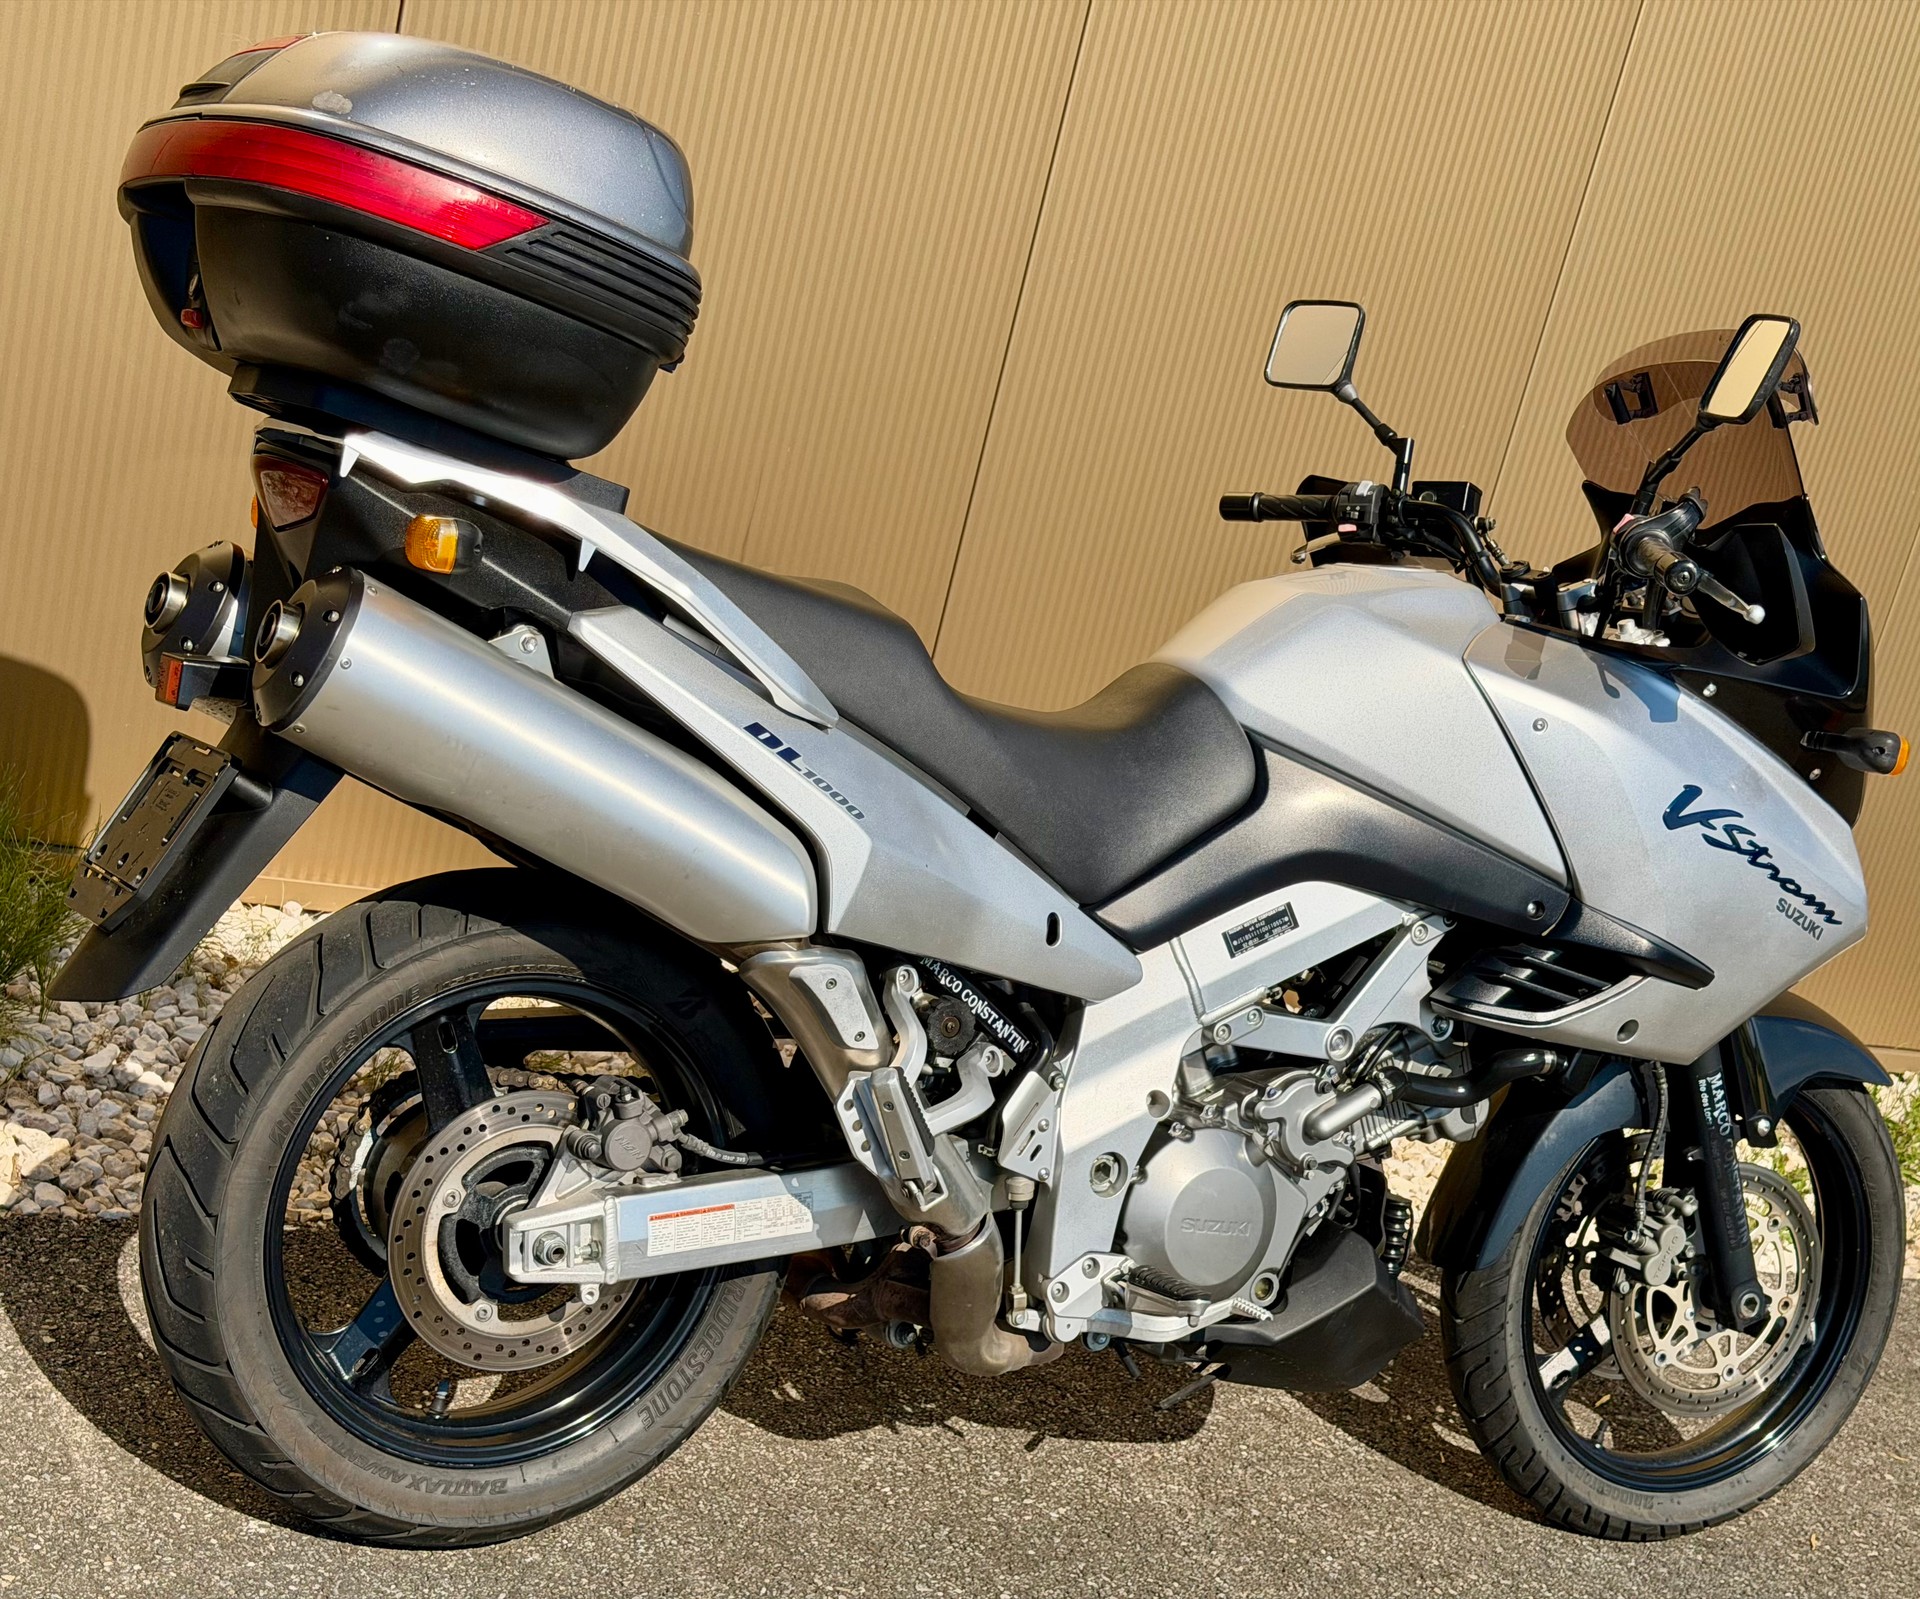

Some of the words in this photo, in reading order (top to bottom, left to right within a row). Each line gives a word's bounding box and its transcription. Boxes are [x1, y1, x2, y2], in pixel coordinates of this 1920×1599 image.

[1775, 897, 1824, 941] SUZUKI
[920, 957, 963, 993] MARCO
[961, 989, 1030, 1054] CONSTANTIN
[275, 984, 421, 1145] BRIDGESTONE
[1706, 1071, 1731, 1136] MARCO
[1181, 1217, 1251, 1237] SUZUKI
[637, 1277, 752, 1431] RIDGESTONE
[405, 1473, 508, 1497] BATTLAX
